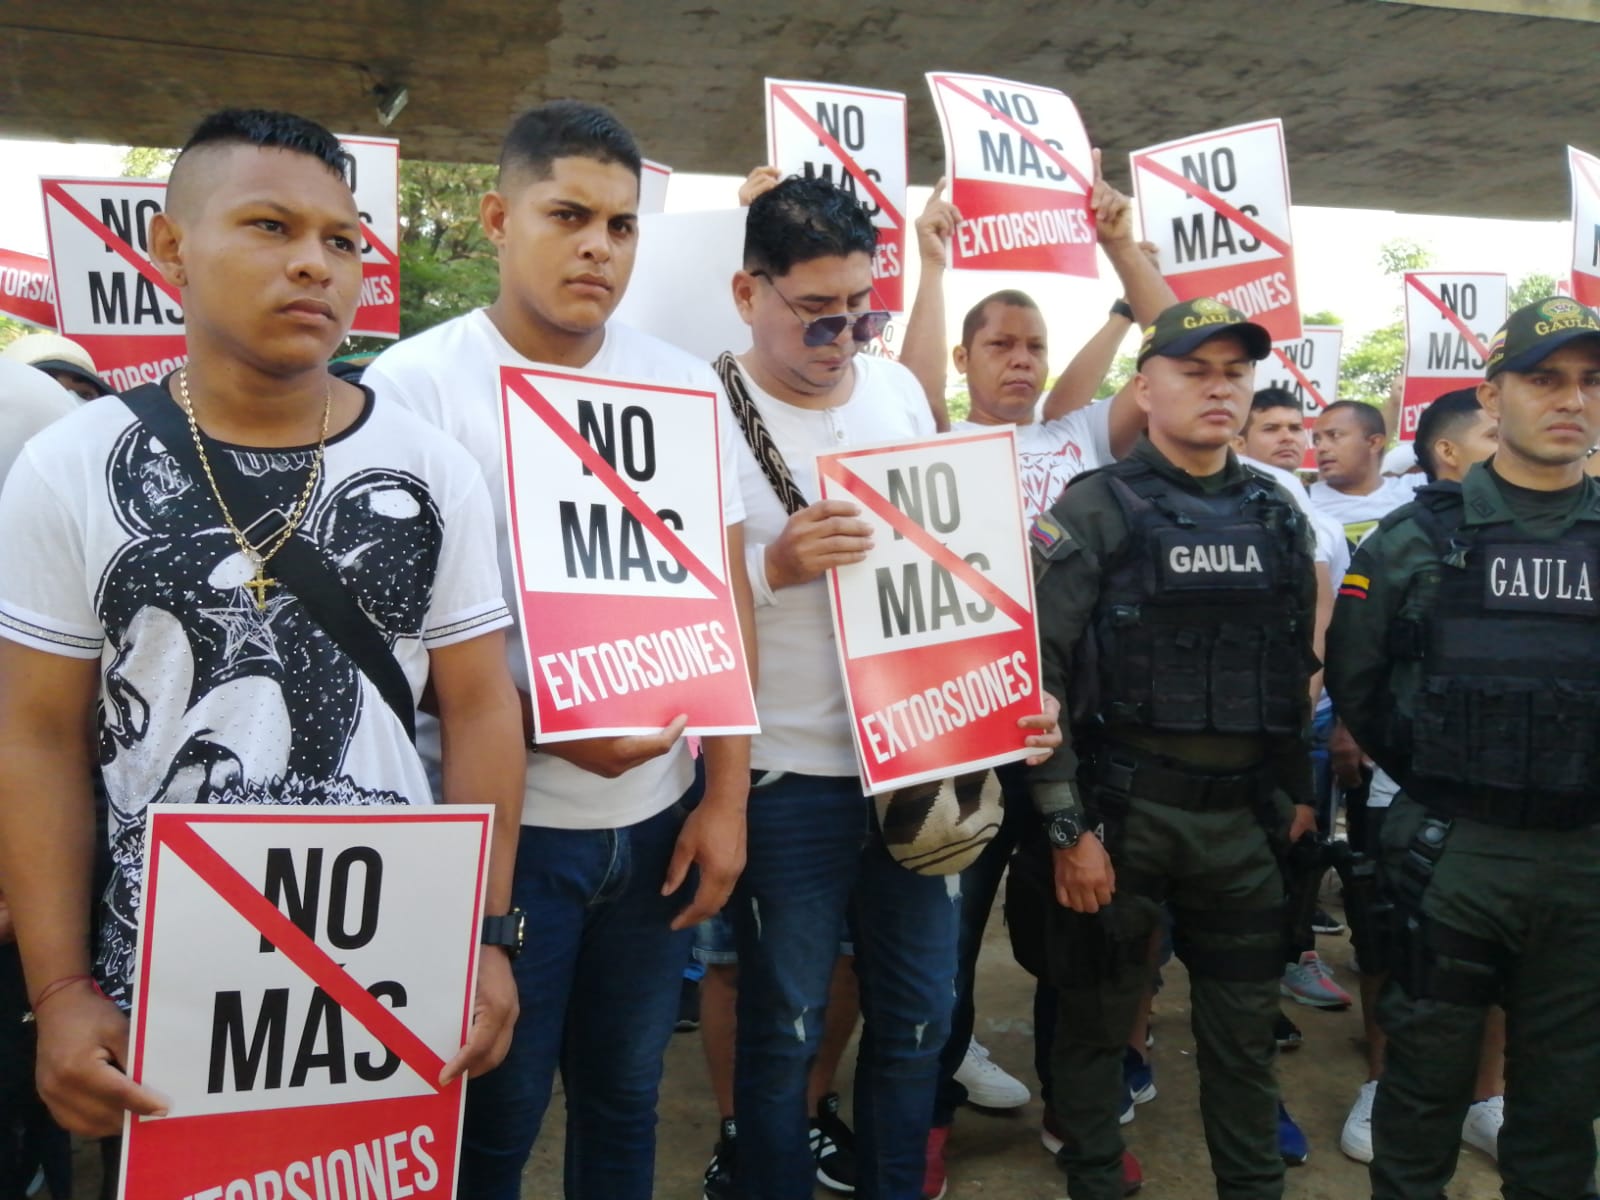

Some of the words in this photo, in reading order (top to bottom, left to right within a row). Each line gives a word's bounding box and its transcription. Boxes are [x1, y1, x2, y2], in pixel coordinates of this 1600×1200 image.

[816, 102, 865, 151] NO
[982, 88, 1039, 125] NO
[1181, 147, 1237, 199] NO
[956, 208, 1092, 258] EXTORSIONES
[1440, 283, 1477, 320] NO
[1535, 316, 1600, 335] GAULA
[1283, 338, 1314, 369] NO
[577, 399, 656, 482] NO
[888, 462, 961, 541] NO
[1169, 545, 1264, 573] GAULA
[1490, 557, 1594, 601] GAULA
[538, 620, 736, 711] EXTORSIONES
[862, 650, 1033, 765] EXTORSIONES
[258, 845, 383, 953] NO
